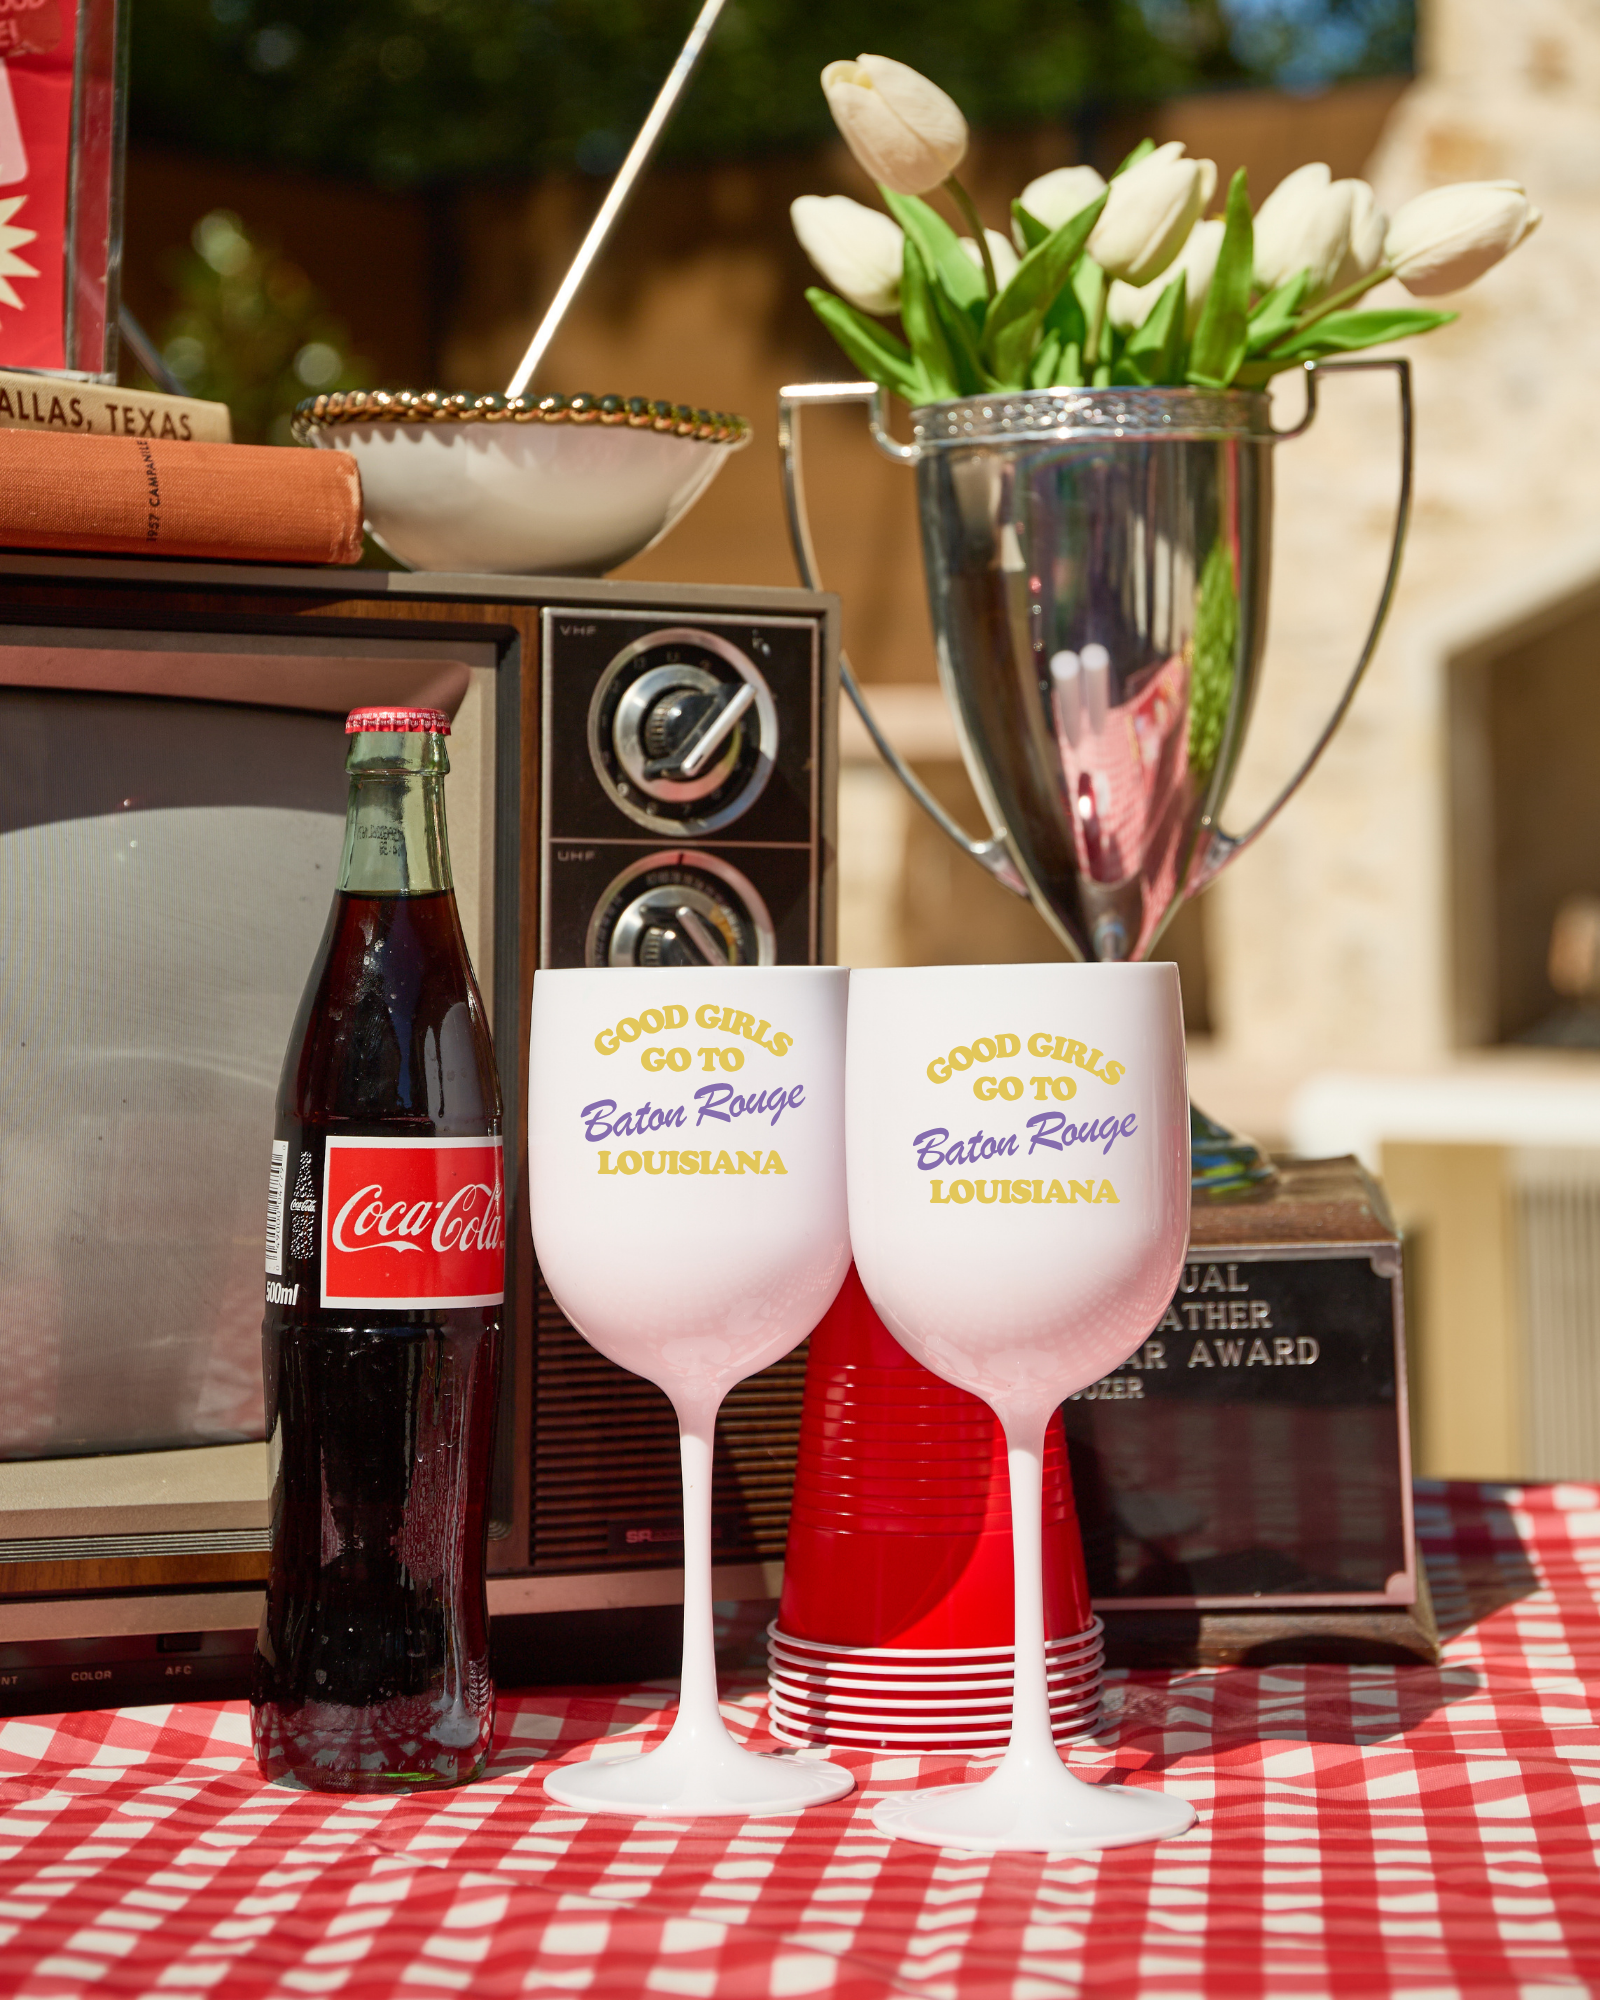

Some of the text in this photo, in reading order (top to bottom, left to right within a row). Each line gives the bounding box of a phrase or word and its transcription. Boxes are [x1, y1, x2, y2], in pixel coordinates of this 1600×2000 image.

[105, 403, 192, 441] TEXAS
[137, 440, 161, 542] 1957 CAMPANILE
[560, 624, 597, 636] VHF
[557, 850, 595, 861] UHF
[594, 1003, 794, 1057] GOOD GIRLS
[641, 1047, 745, 1073] GO TO
[926, 1032, 1126, 1086] GOOD GIRLS
[972, 1076, 1078, 1102] GO TO
[580, 1083, 806, 1142] Baton Rouge
[912, 1111, 1139, 1171] Baton Rouge
[597, 1149, 789, 1175] LOUISIANA
[289, 1198, 317, 1212] Coca-Cola
[929, 1179, 1121, 1205] LOUISIANA
[331, 1183, 502, 1253] Coca-Cola
[265, 1280, 300, 1306] 500ml
[1156, 1300, 1273, 1332] ATHER
[1187, 1336, 1321, 1369] AWARD
[71, 1670, 112, 1682] COLOR
[165, 1665, 192, 1676] AFC
